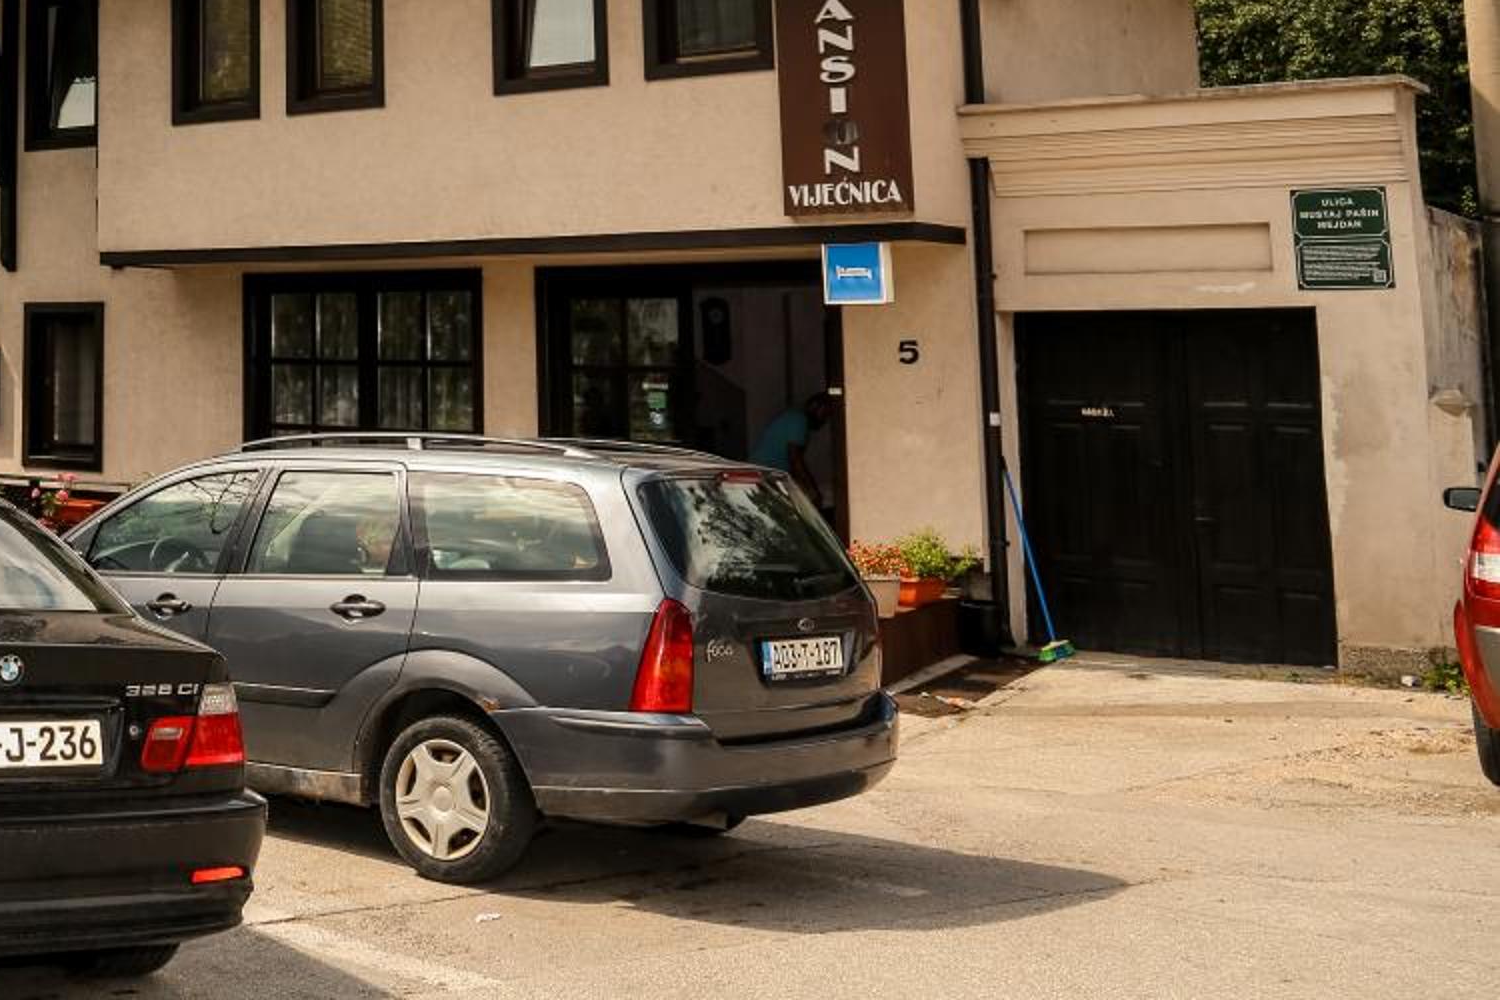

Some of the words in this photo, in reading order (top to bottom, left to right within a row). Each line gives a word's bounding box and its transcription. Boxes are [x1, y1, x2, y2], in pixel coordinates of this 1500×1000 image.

[788, 176, 903, 207] VIJEĆNICA
[1321, 197, 1354, 207] ULICA
[1345, 208, 1380, 218] PAŠIN
[898, 340, 919, 364] 5
